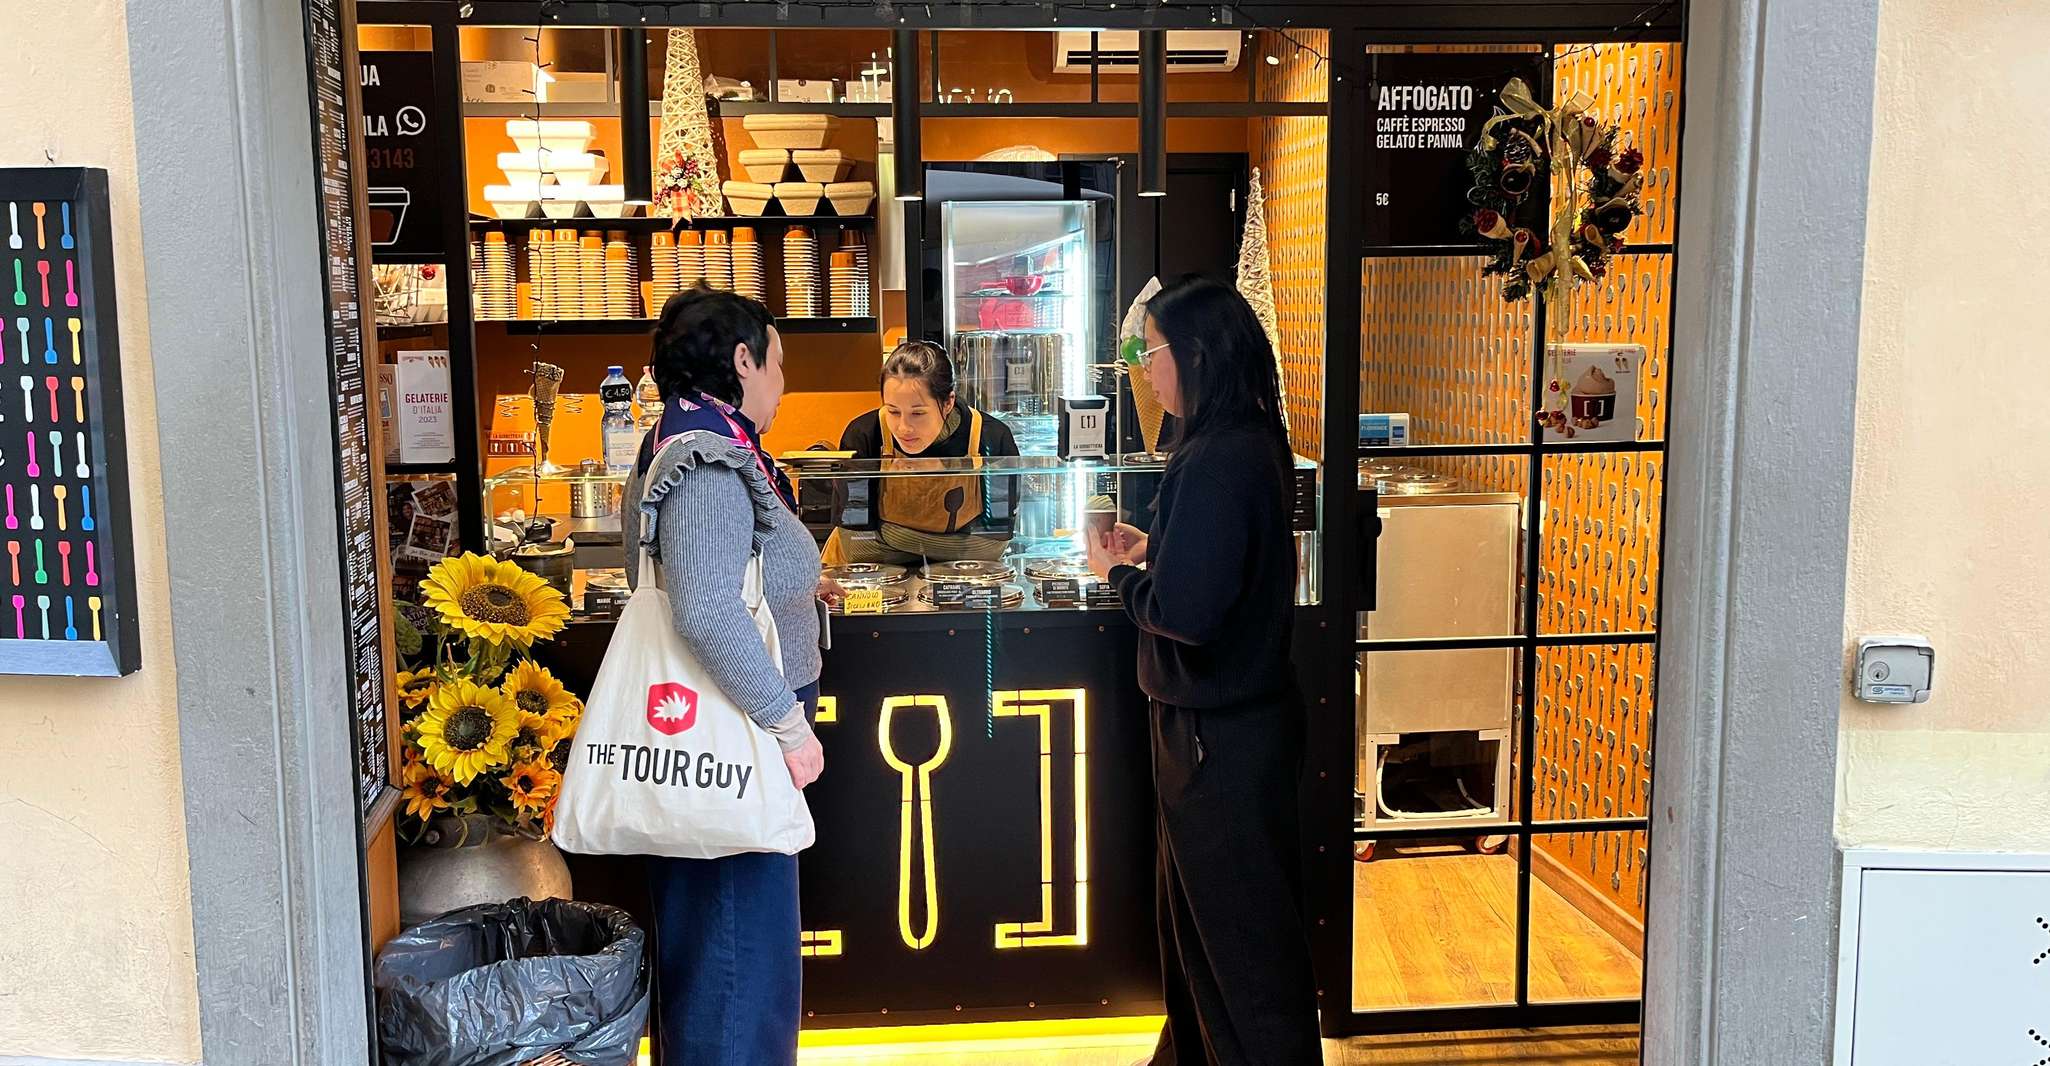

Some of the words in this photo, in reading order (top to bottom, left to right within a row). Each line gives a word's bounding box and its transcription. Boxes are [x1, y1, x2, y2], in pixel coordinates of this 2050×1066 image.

[1378, 85, 1473, 111] AFFOGATO
[1376, 115, 1410, 132] CAFFÈ
[1412, 117, 1465, 132] ESPRESSO
[1376, 134, 1416, 149] GELATO
[1418, 134, 1425, 148] E
[1427, 134, 1463, 149] PANNA
[367, 148, 414, 169] 3143
[1376, 193, 1389, 206] 5€
[405, 393, 449, 403] GELATERIE
[413, 406, 442, 414] D'ITALIA
[587, 744, 616, 765] THE
[620, 744, 690, 787] TOUR
